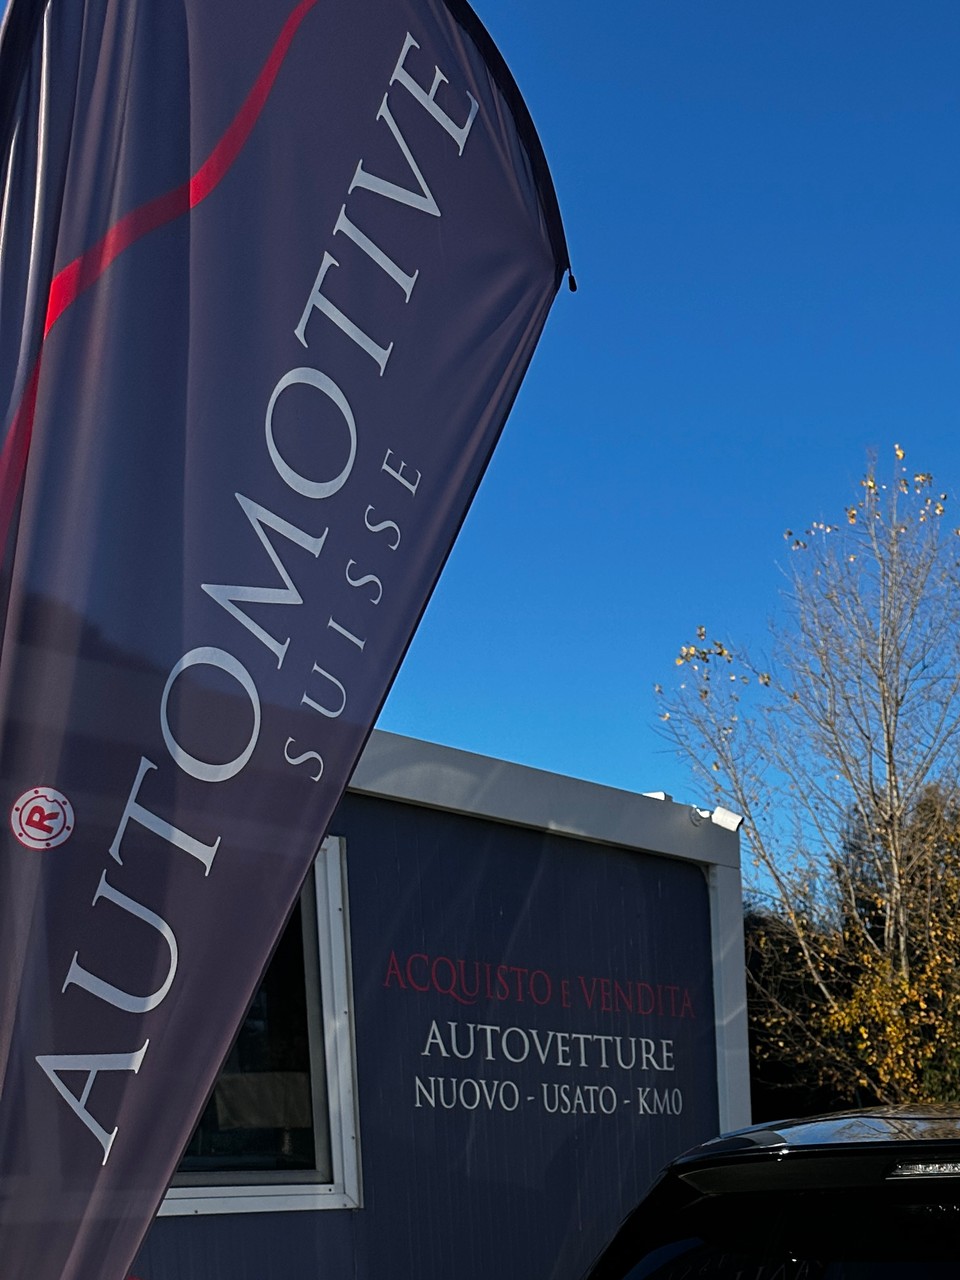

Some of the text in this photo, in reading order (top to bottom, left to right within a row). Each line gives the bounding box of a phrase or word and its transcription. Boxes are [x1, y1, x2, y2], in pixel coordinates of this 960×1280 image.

[35, 31, 480, 1167] AUTOMOTIVE
[284, 448, 422, 782] SUISSE
[383, 950, 551, 1005] ACQUISTO
[578, 976, 696, 1018] VENDITA
[421, 1019, 675, 1072] AUTOVETTURE
[414, 1075, 520, 1112] NUOVO
[541, 1083, 617, 1114] USATO
